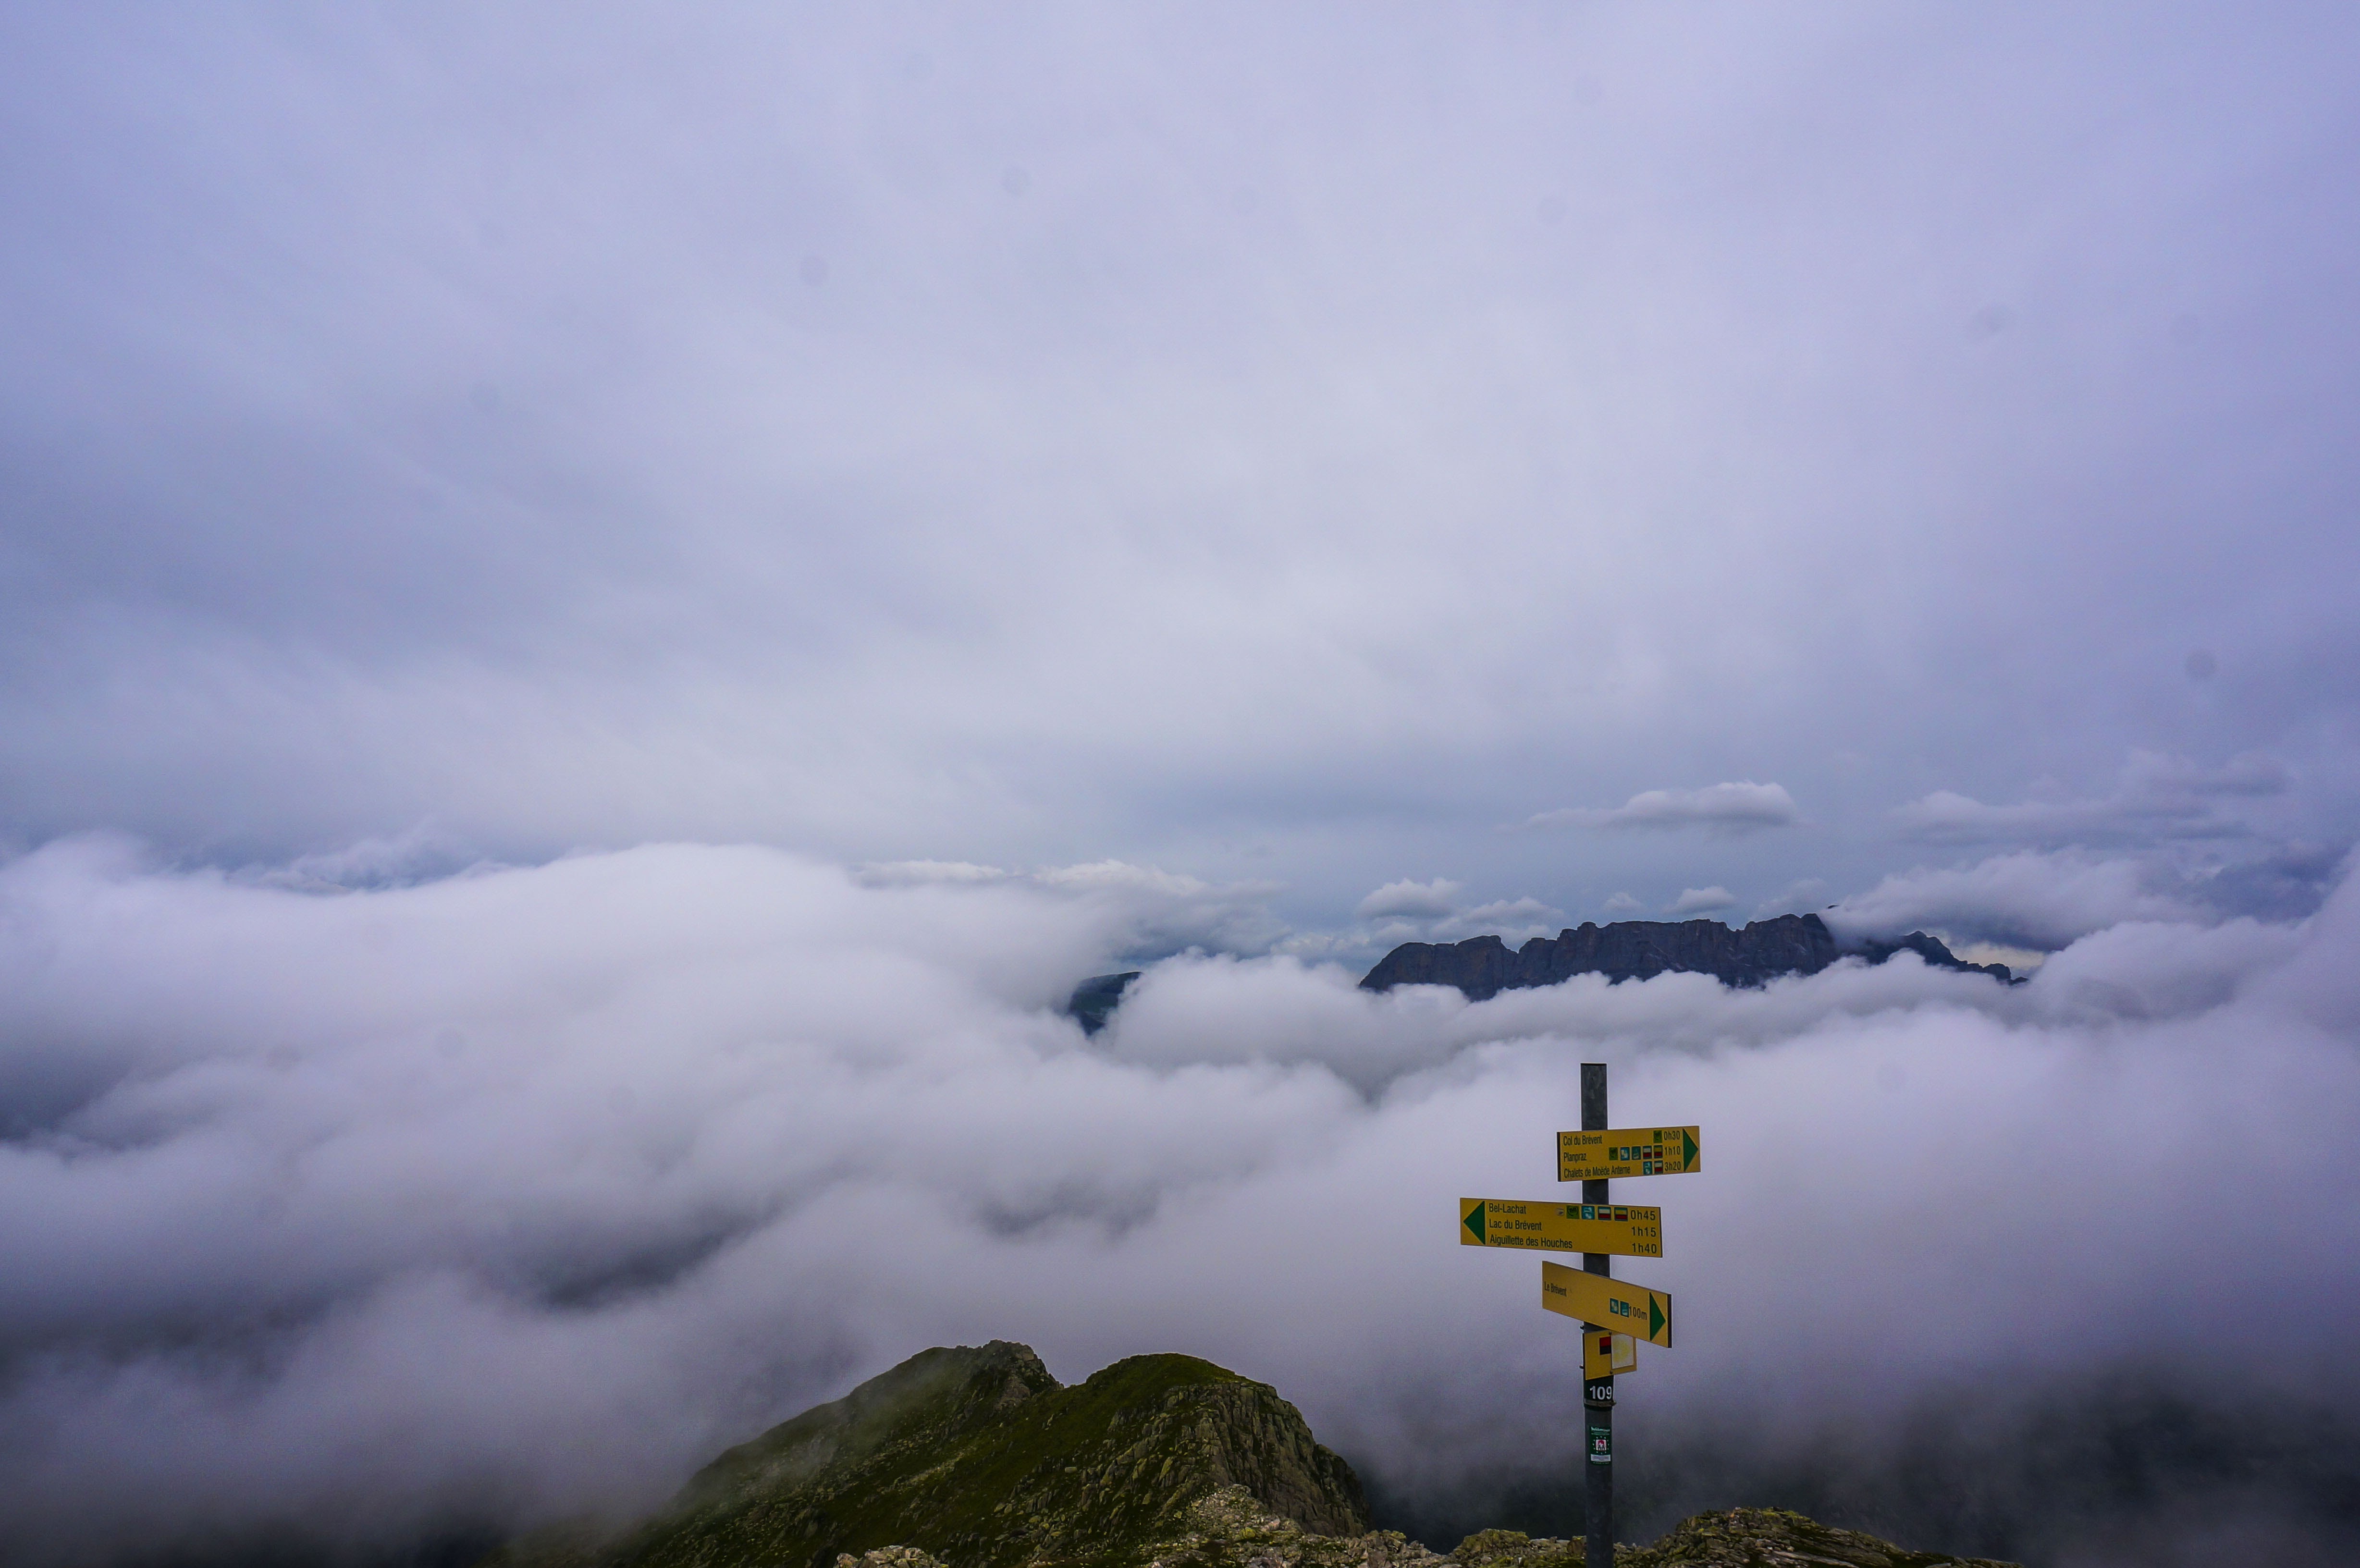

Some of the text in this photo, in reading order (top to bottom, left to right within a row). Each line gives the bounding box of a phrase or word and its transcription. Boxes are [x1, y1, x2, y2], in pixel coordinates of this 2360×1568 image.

[1563, 1135, 1602, 1146] Col du Brévent
[1664, 1130, 1680, 1140] 0h30
[1664, 1146, 1681, 1155] 1h10
[1564, 1152, 1587, 1163] Planpraz
[1564, 1167, 1584, 1178] Chalets
[1585, 1167, 1591, 1176] de
[1611, 1165, 1630, 1175] Anterne
[1664, 1161, 1681, 1171] 3h20
[1488, 1203, 1526, 1214] Bel-Lachat
[1631, 1210, 1656, 1220] 0h45
[1489, 1219, 1542, 1231] Lac du Brévent
[1631, 1226, 1657, 1237] 1h15
[1490, 1234, 1573, 1249] Aiguillette des Houches
[1632, 1243, 1657, 1253] 1h40
[1544, 1281, 1567, 1297] Le Brévent
[1629, 1306, 1647, 1320] 100m
[1589, 1385, 1612, 1400] 109
